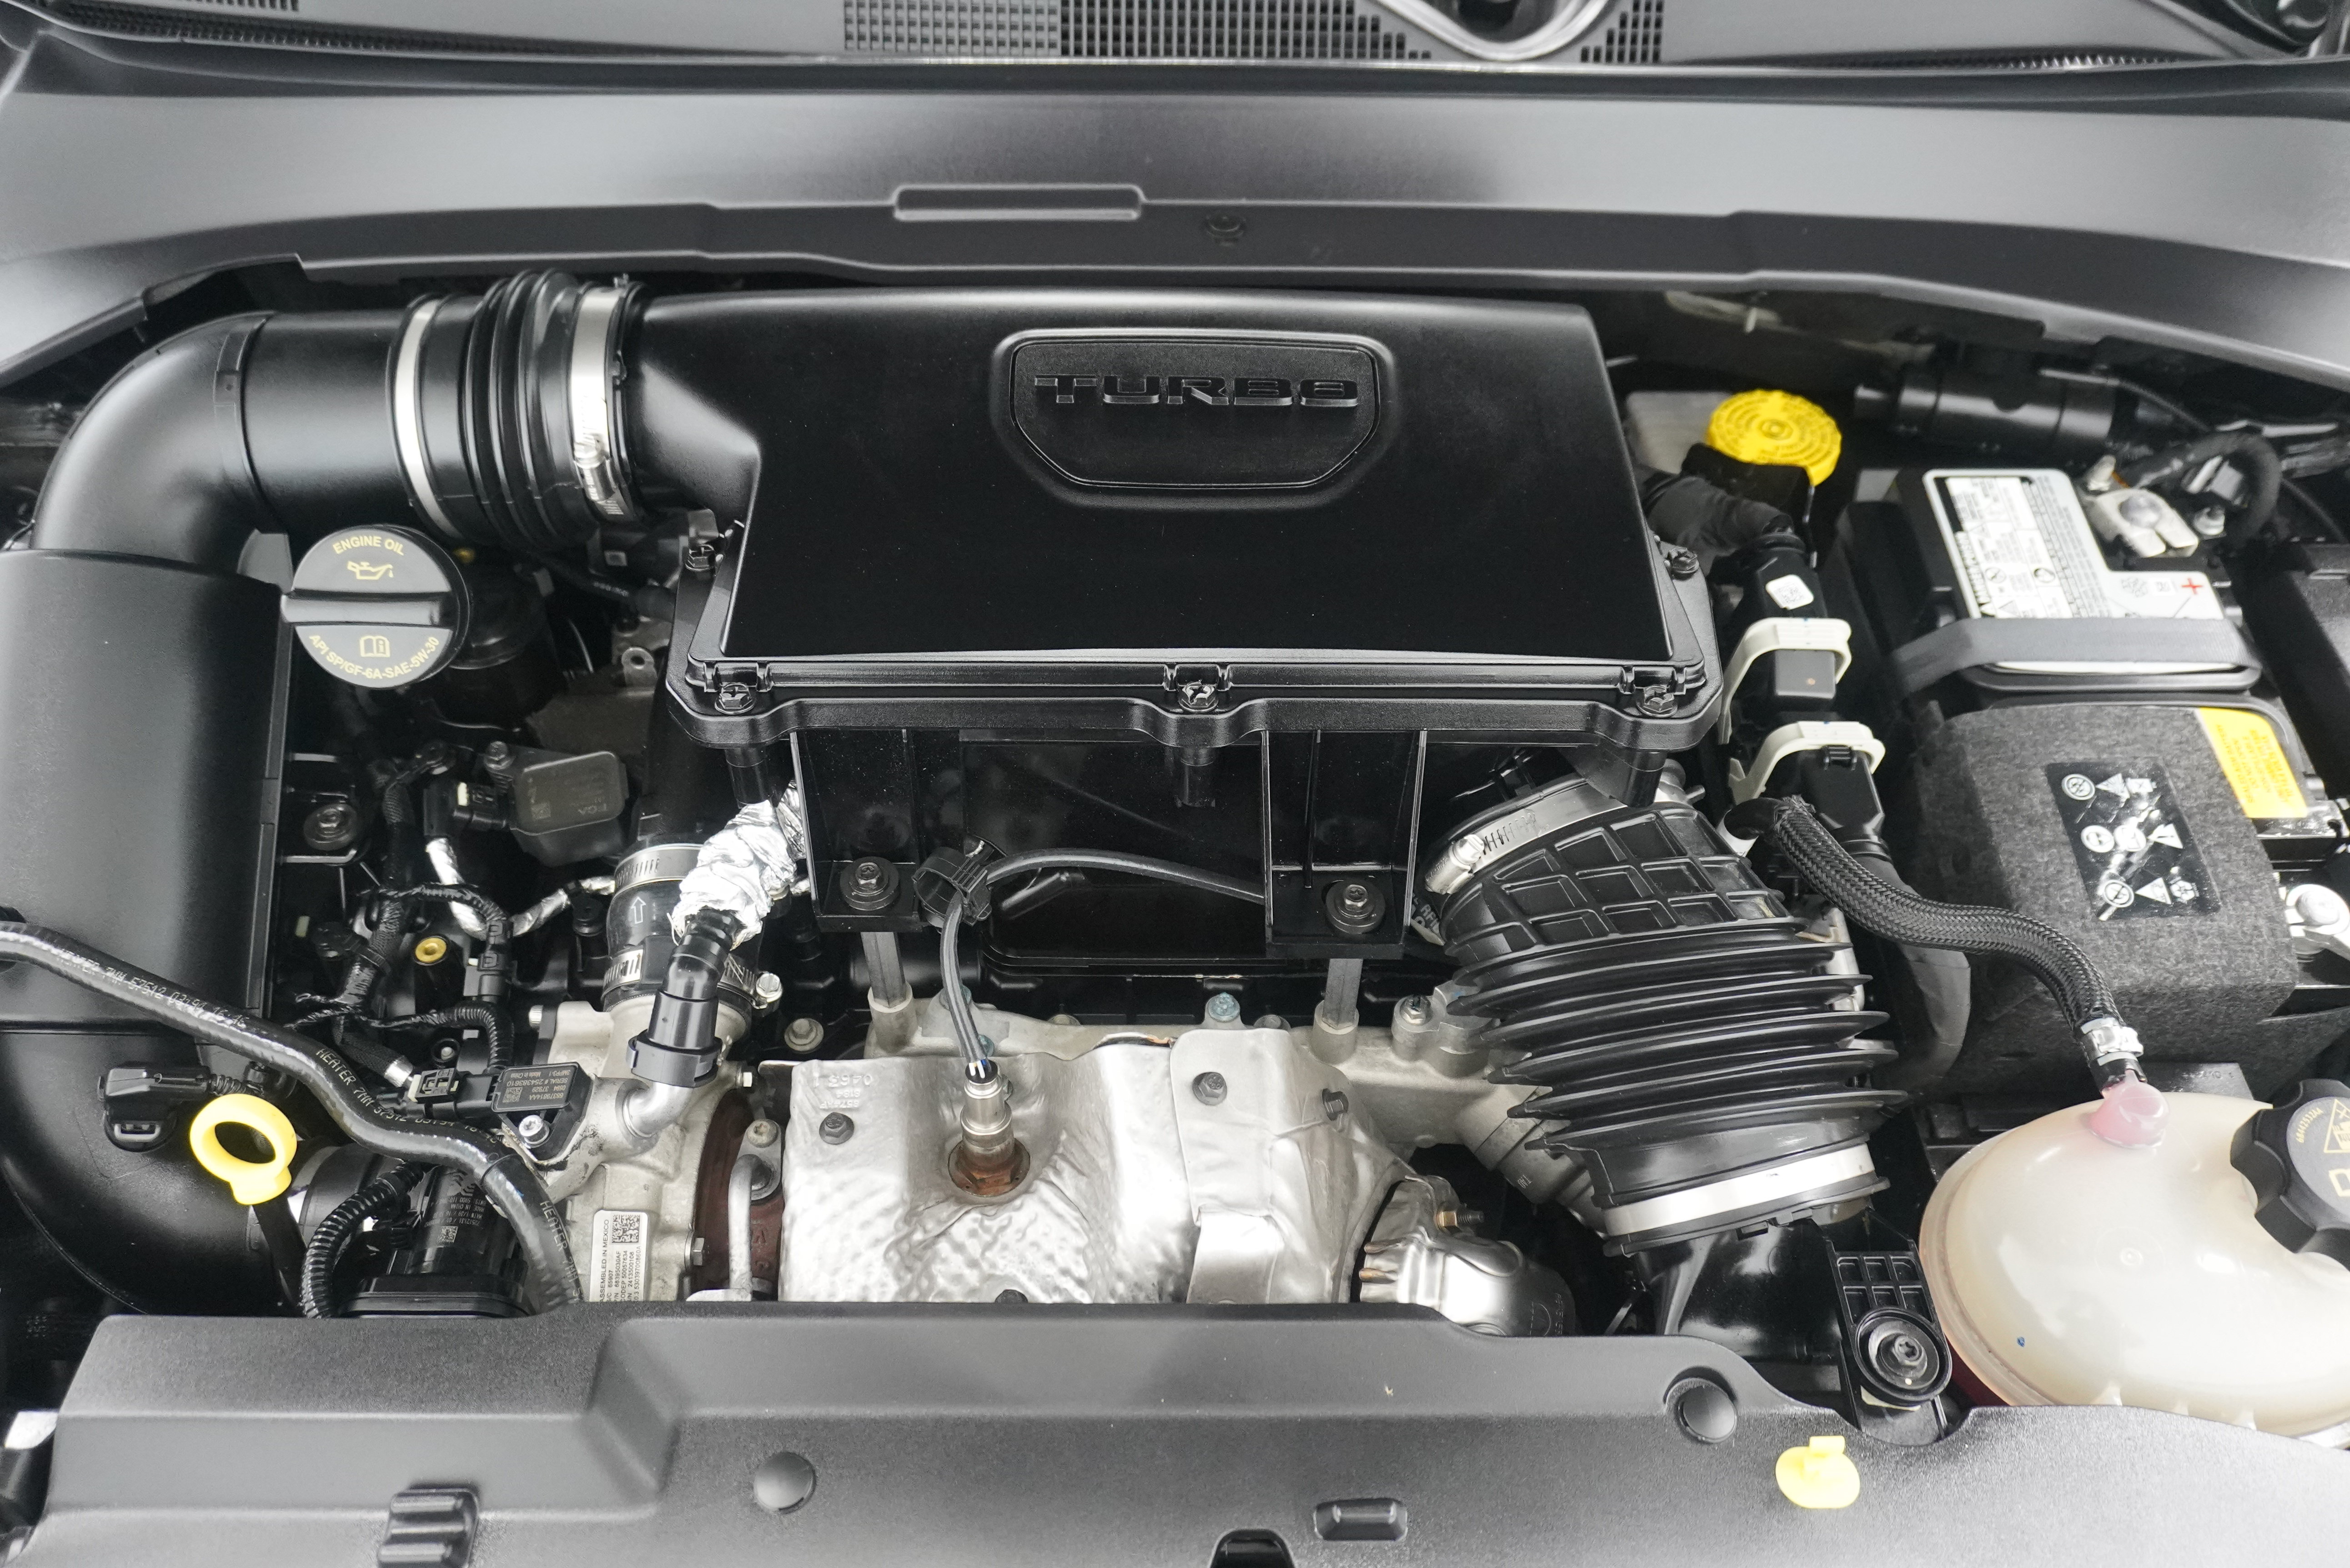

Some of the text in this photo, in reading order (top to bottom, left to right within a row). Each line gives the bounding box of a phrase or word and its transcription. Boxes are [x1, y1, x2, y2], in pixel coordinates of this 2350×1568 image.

[1034, 374, 1359, 407] TURBO
[332, 536, 405, 556] ENGINE OIL
[309, 634, 328, 655] API
[316, 1048, 357, 1086] HEATER
[539, 1201, 568, 1251] HEATER
